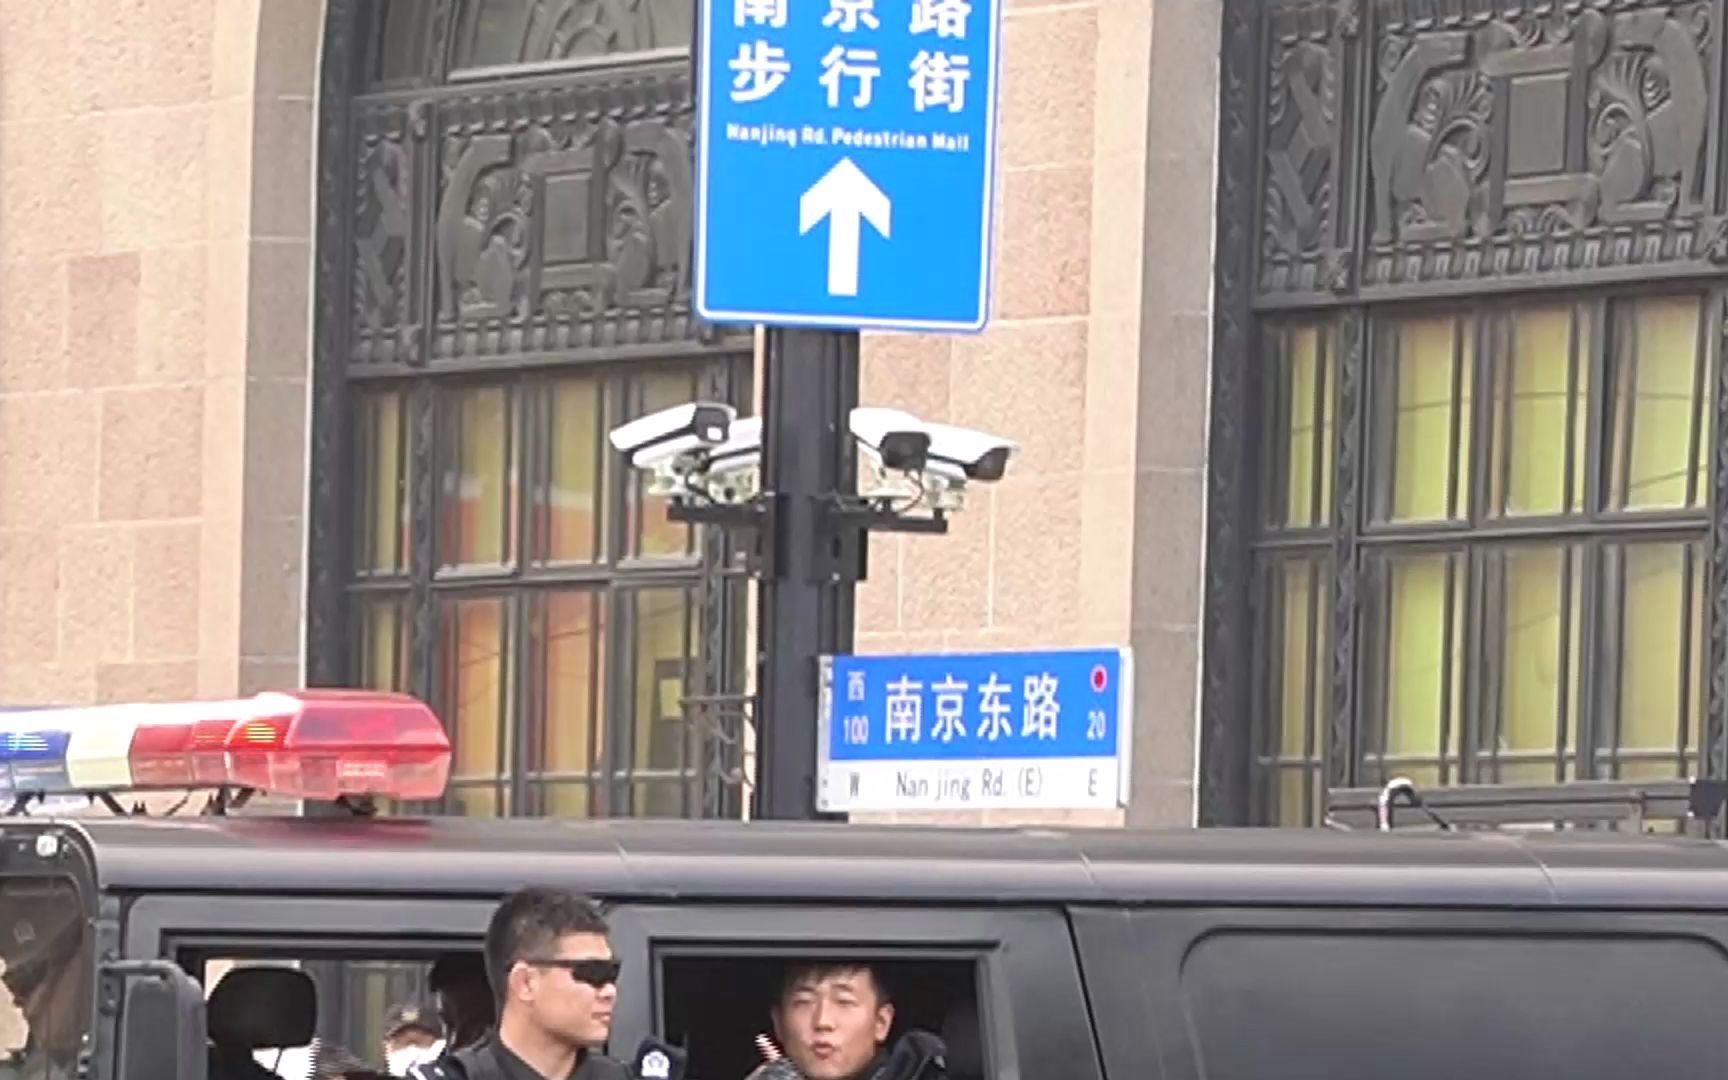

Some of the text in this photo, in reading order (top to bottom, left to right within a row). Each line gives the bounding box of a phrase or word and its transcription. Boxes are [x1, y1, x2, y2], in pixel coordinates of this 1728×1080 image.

[728, 39, 971, 113] 步行街
[726, 122, 970, 152] Nanjing Rd. Pedestrian Mall
[847, 671, 866, 701] 西
[884, 671, 1061, 744] 南京东路
[843, 715, 869, 745] 100
[1086, 710, 1107, 740] 20
[849, 771, 860, 796] W
[1018, 765, 1043, 797] (E)
[1087, 767, 1098, 797] E
